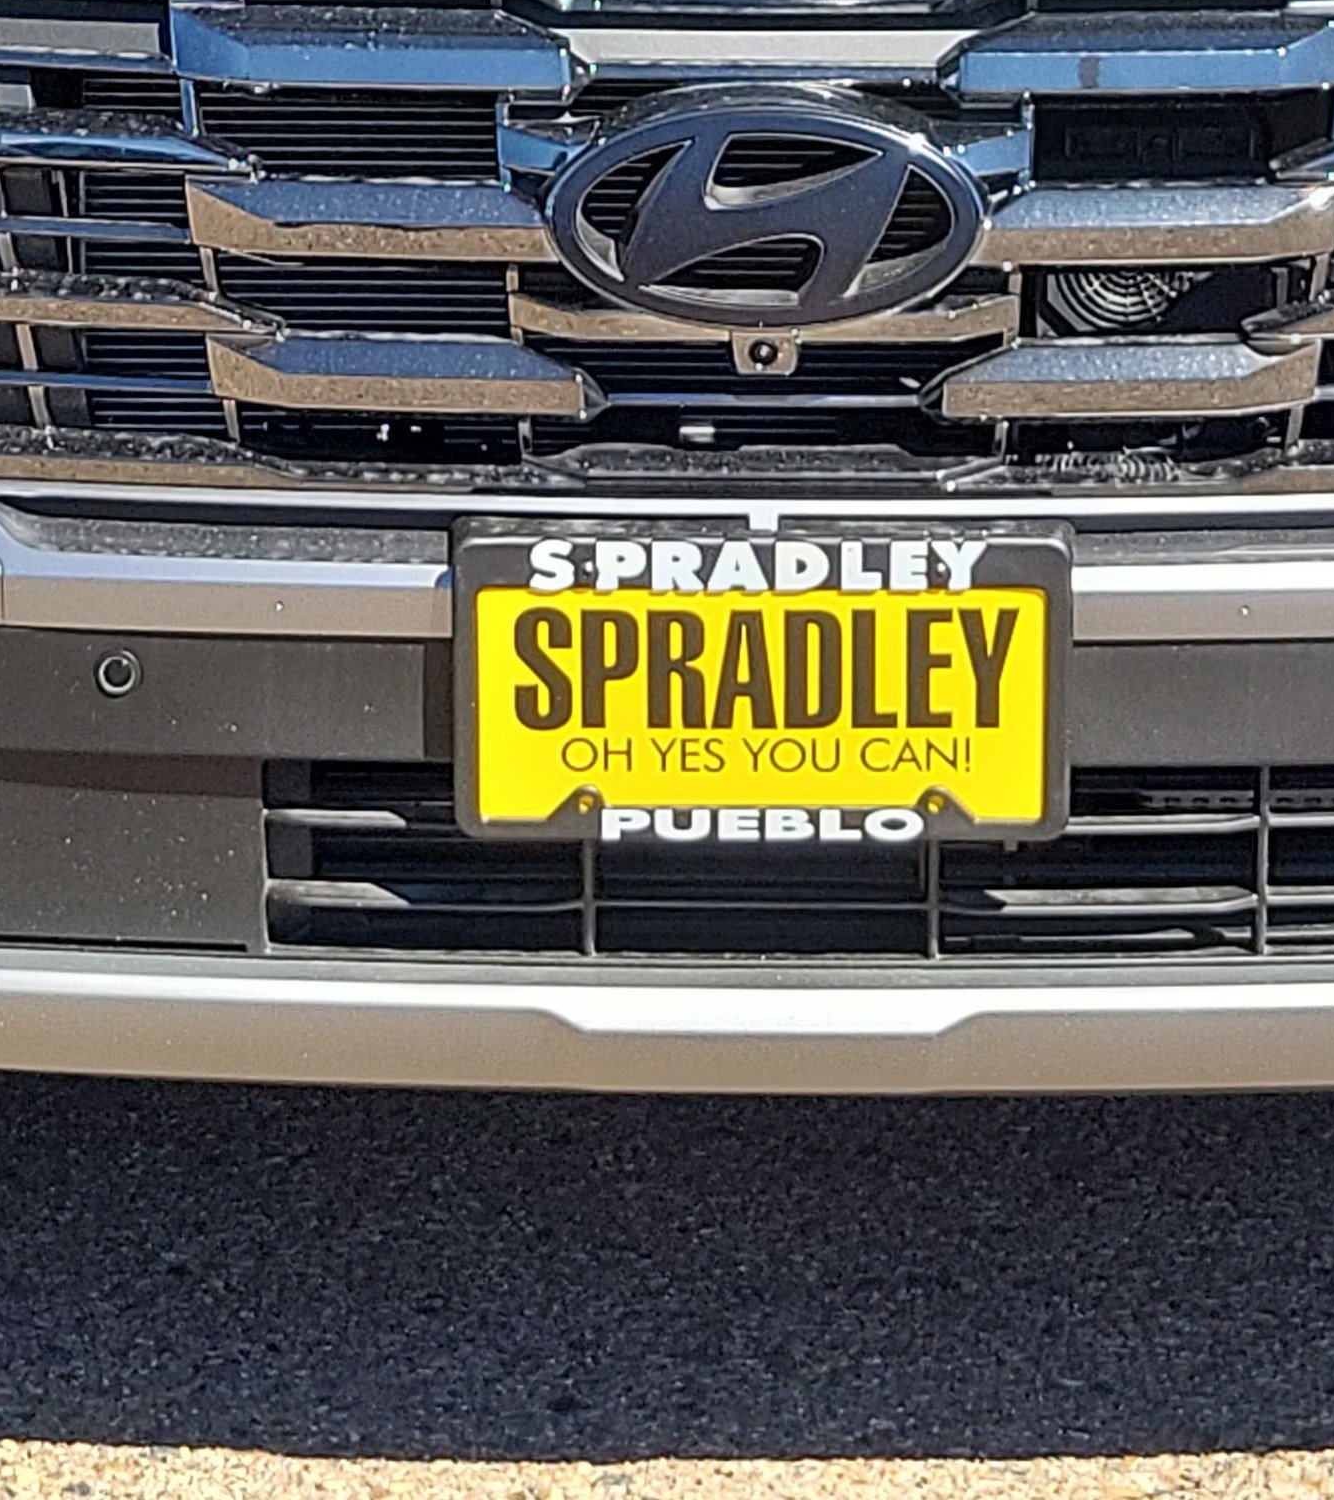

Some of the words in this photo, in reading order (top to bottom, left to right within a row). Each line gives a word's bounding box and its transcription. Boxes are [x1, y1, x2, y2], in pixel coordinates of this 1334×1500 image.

[528, 537, 987, 592] SPRADLEY
[513, 606, 1020, 730] SPRADLEY
[561, 737, 632, 773] OH
[651, 737, 725, 773] YES
[743, 737, 840, 773] YOU
[860, 737, 972, 773] CAN!
[600, 807, 925, 842] PUEBLO
